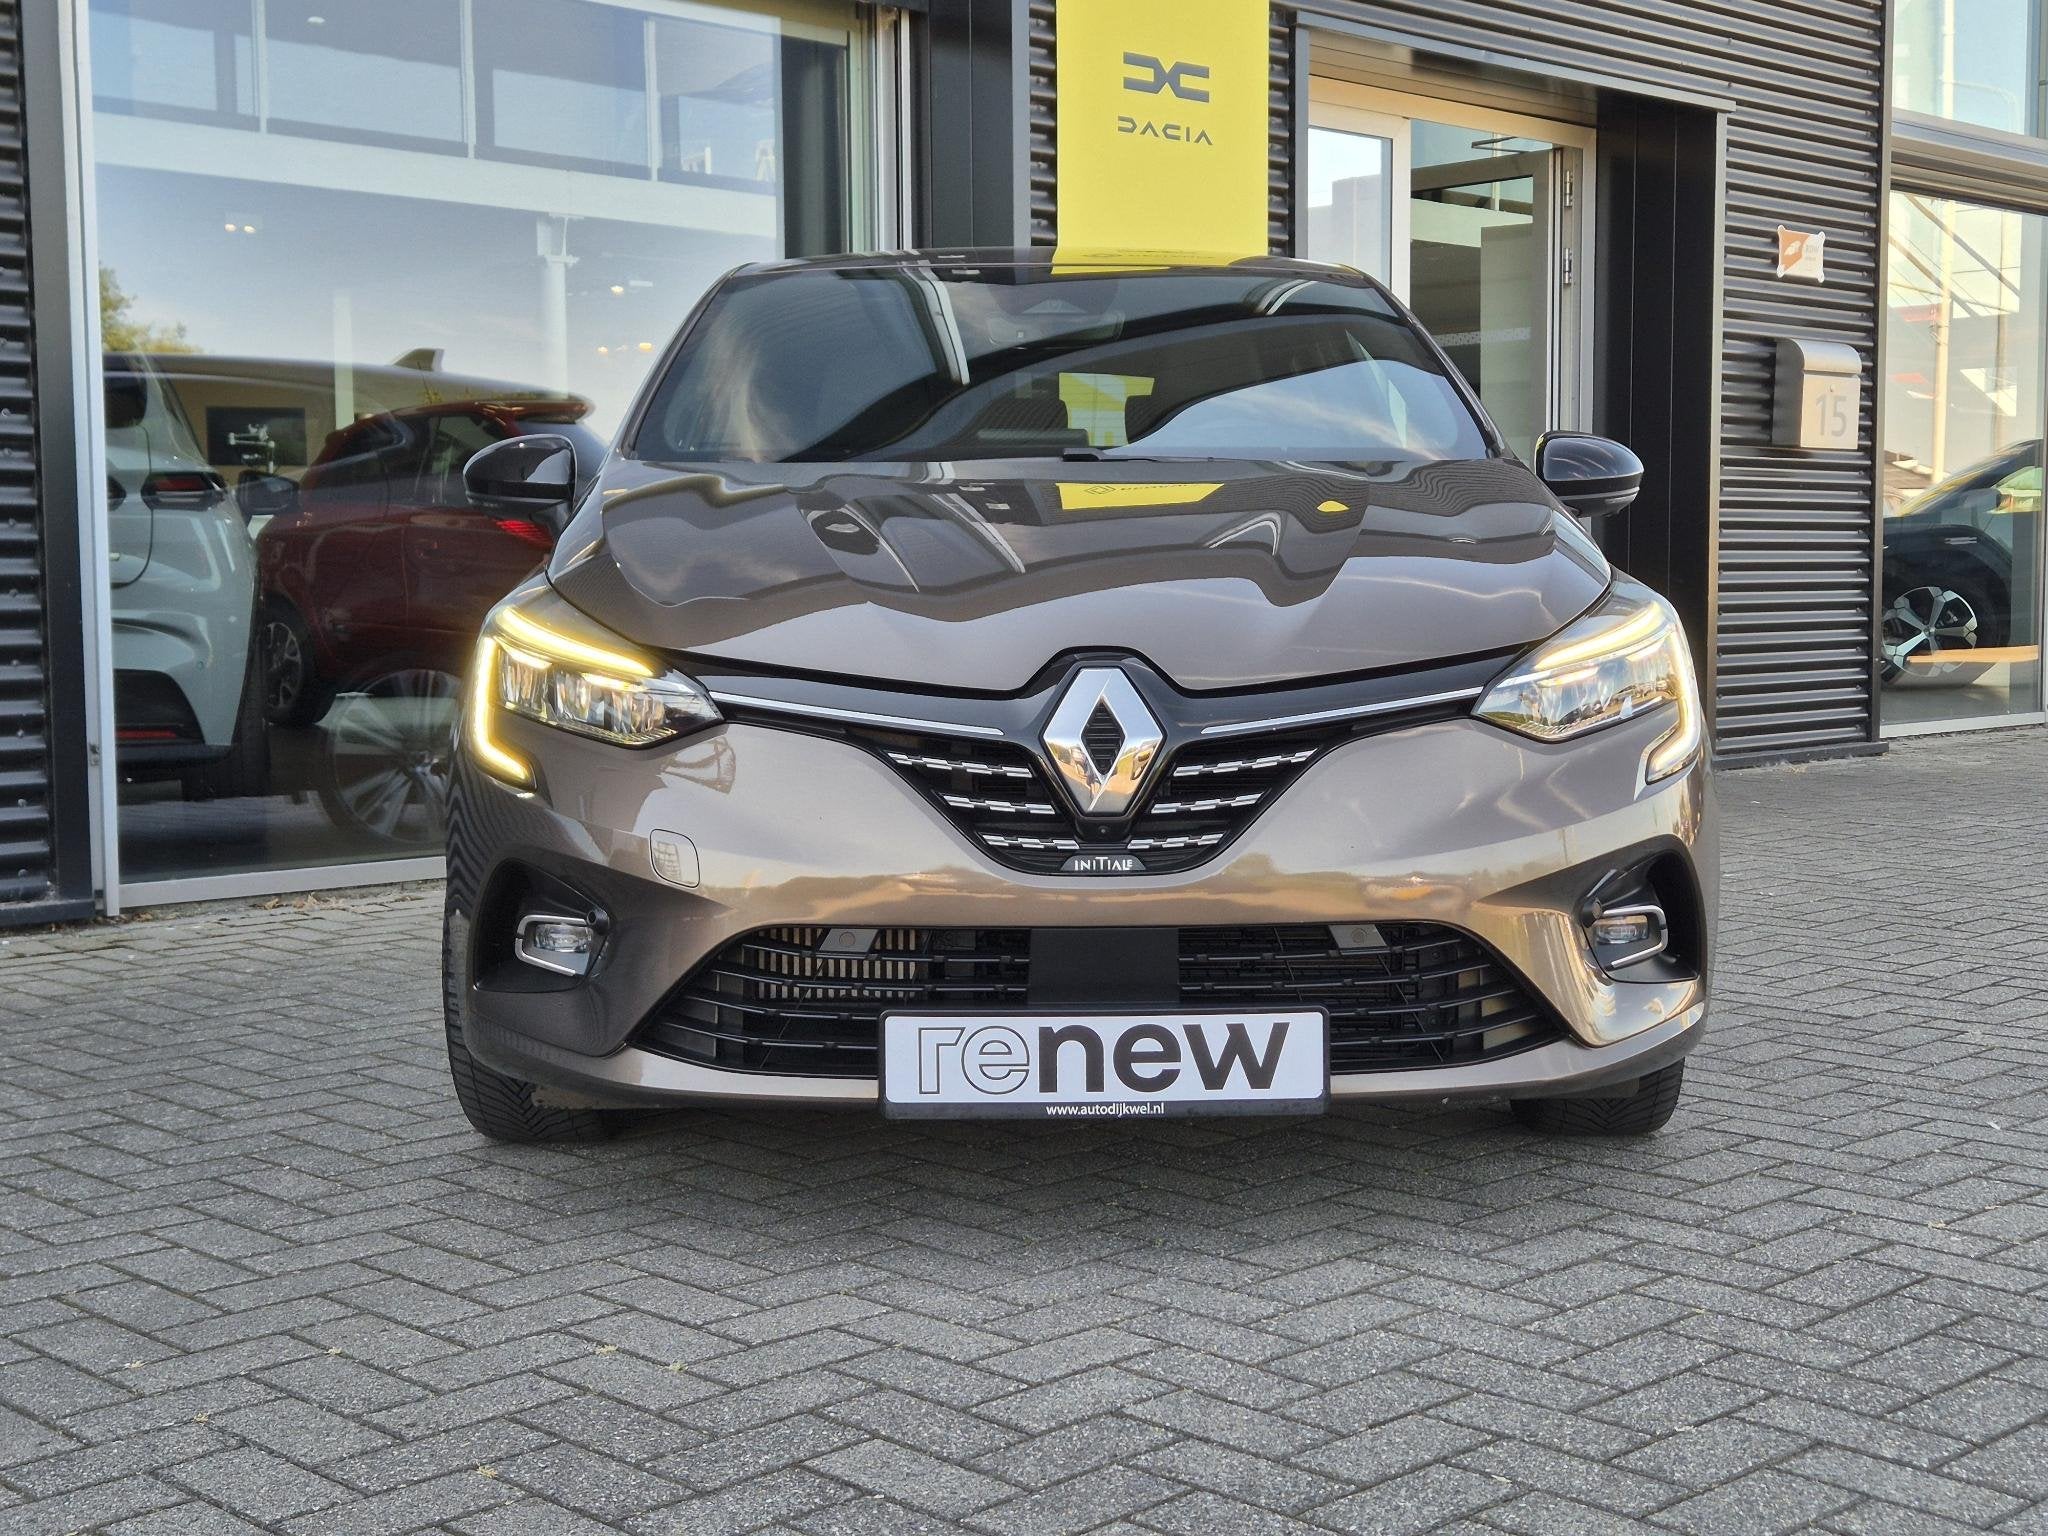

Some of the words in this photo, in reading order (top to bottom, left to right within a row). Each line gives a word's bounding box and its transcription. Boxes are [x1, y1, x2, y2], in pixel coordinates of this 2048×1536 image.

[1117, 115, 1213, 146] DACIA
[1816, 393, 1849, 438] 15
[1074, 856, 1134, 871] INITIALE
[918, 1022, 1290, 1094] renew
[1046, 1102, 1165, 1118] www.autodijkwel.nl
